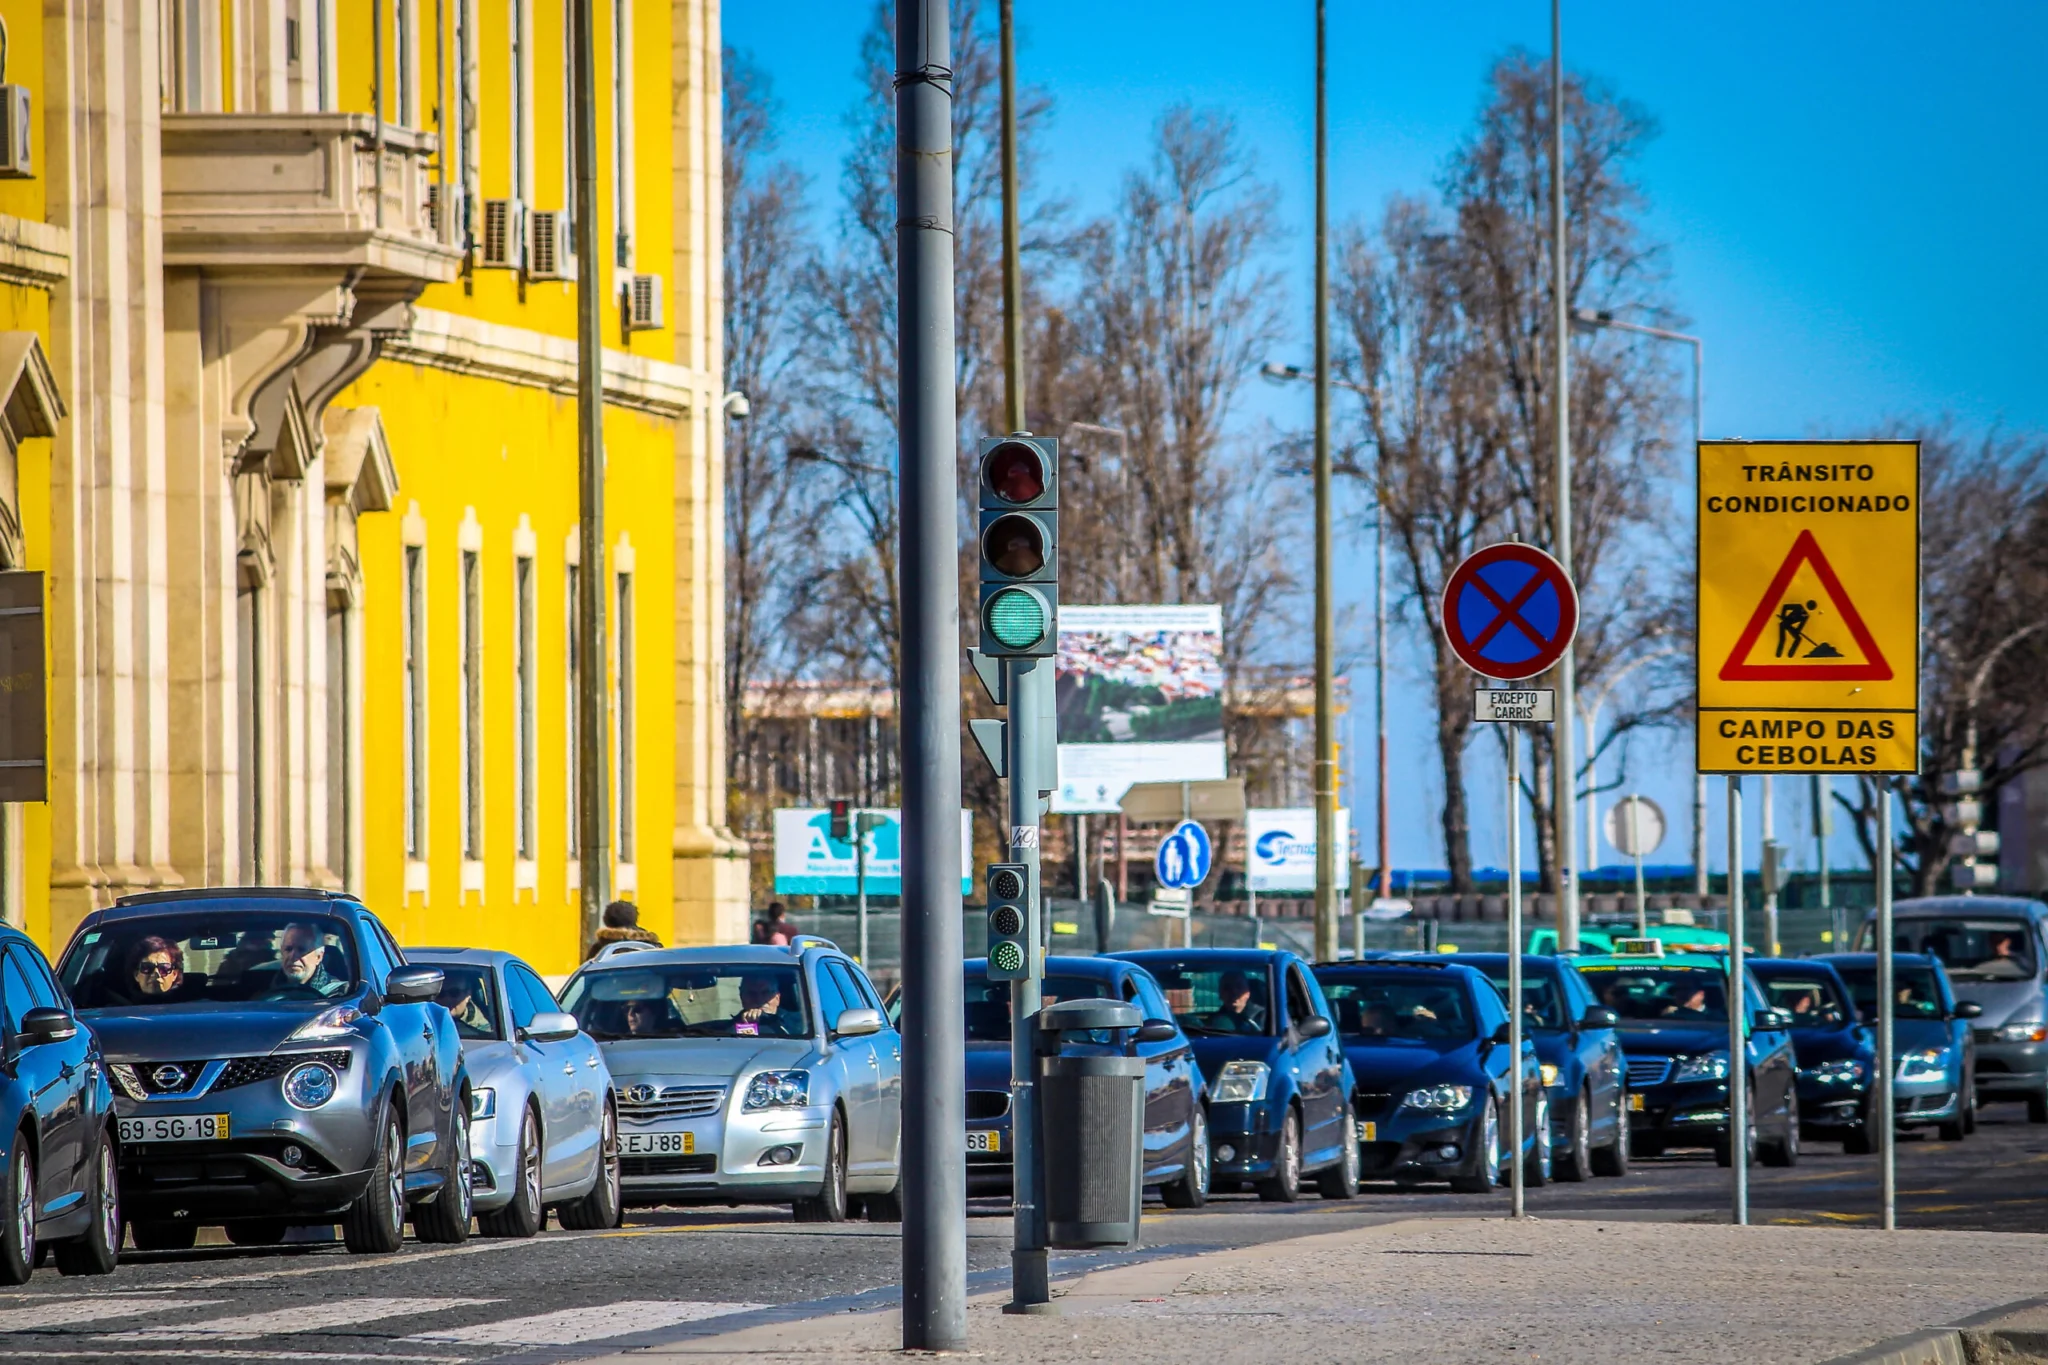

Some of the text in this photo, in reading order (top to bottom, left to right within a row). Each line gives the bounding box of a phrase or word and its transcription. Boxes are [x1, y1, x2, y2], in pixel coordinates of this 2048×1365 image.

[1742, 461, 1875, 483] TRÂNSITO
[1707, 495, 1911, 514] CONDICIONADO
[1490, 692, 1538, 705] EXCEPTO
[1495, 706, 1534, 719] CARRIS
[1719, 718, 1896, 740] CAMPO DAS
[1736, 744, 1877, 766] CEBOLAS
